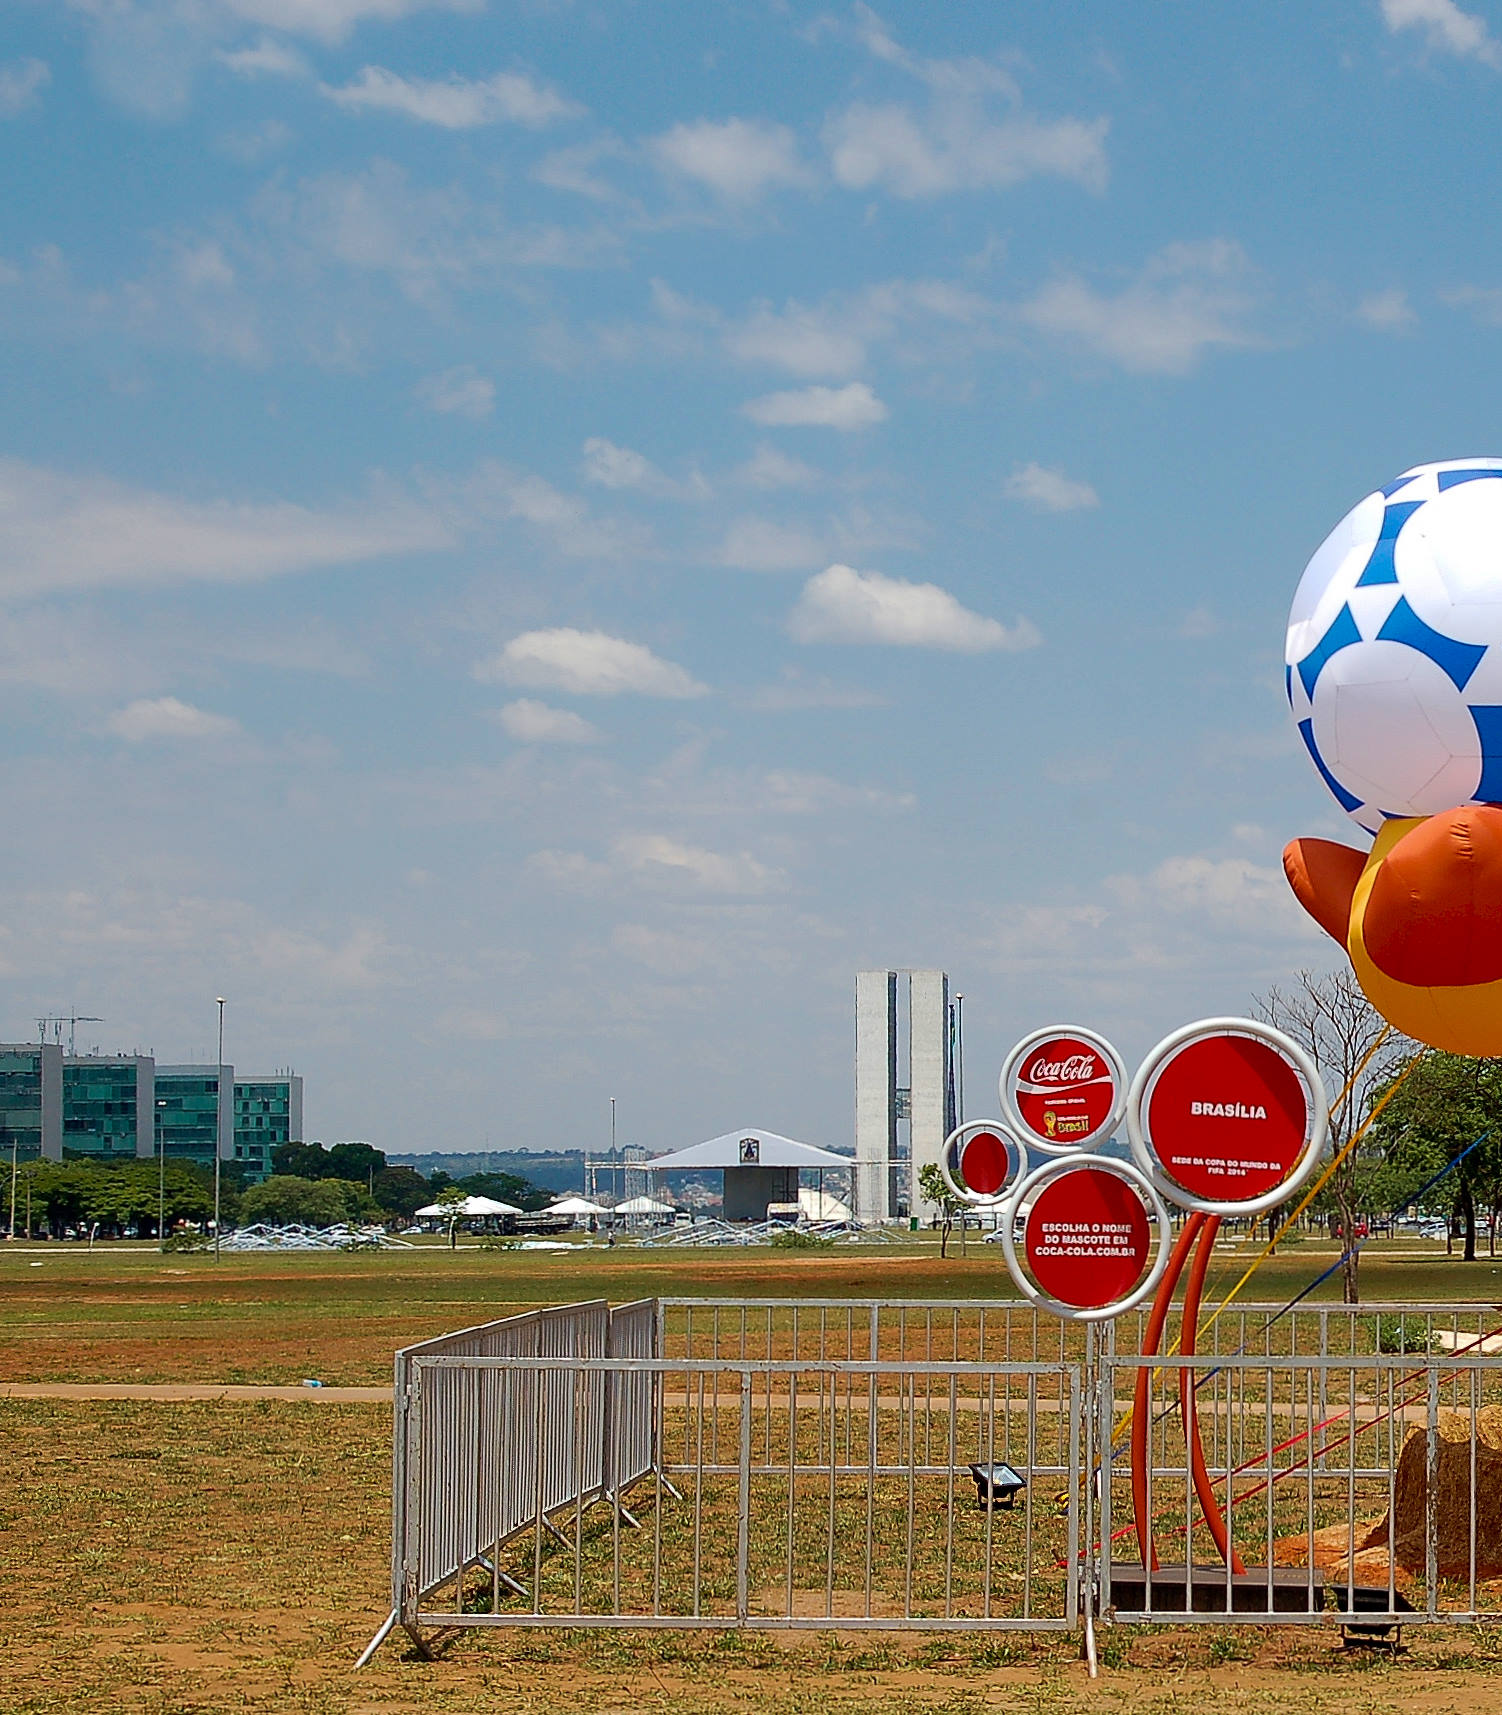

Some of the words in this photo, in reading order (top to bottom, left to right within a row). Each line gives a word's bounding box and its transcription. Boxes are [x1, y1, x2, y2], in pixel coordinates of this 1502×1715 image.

[1030, 1055, 1096, 1082] Coca-Cola
[1191, 1101, 1267, 1119] BRASÍLIA
[1171, 1156, 1192, 1165] SEDE
[1193, 1157, 1204, 1165] DA
[1205, 1158, 1226, 1167] COPA
[1227, 1159, 1239, 1168] DO
[1239, 1160, 1268, 1169] MUNDO
[1269, 1162, 1281, 1171] DA
[1207, 1167, 1225, 1175] FIFA
[1041, 1223, 1090, 1233] ESCOLHA
[1092, 1223, 1100, 1233] O
[1102, 1224, 1132, 1233] NOME
[1044, 1234, 1060, 1244] DO
[1062, 1235, 1111, 1245] MASCOTE
[1113, 1236, 1129, 1245] EM
[1035, 1246, 1136, 1257] COCA-COLA.COM.BR
